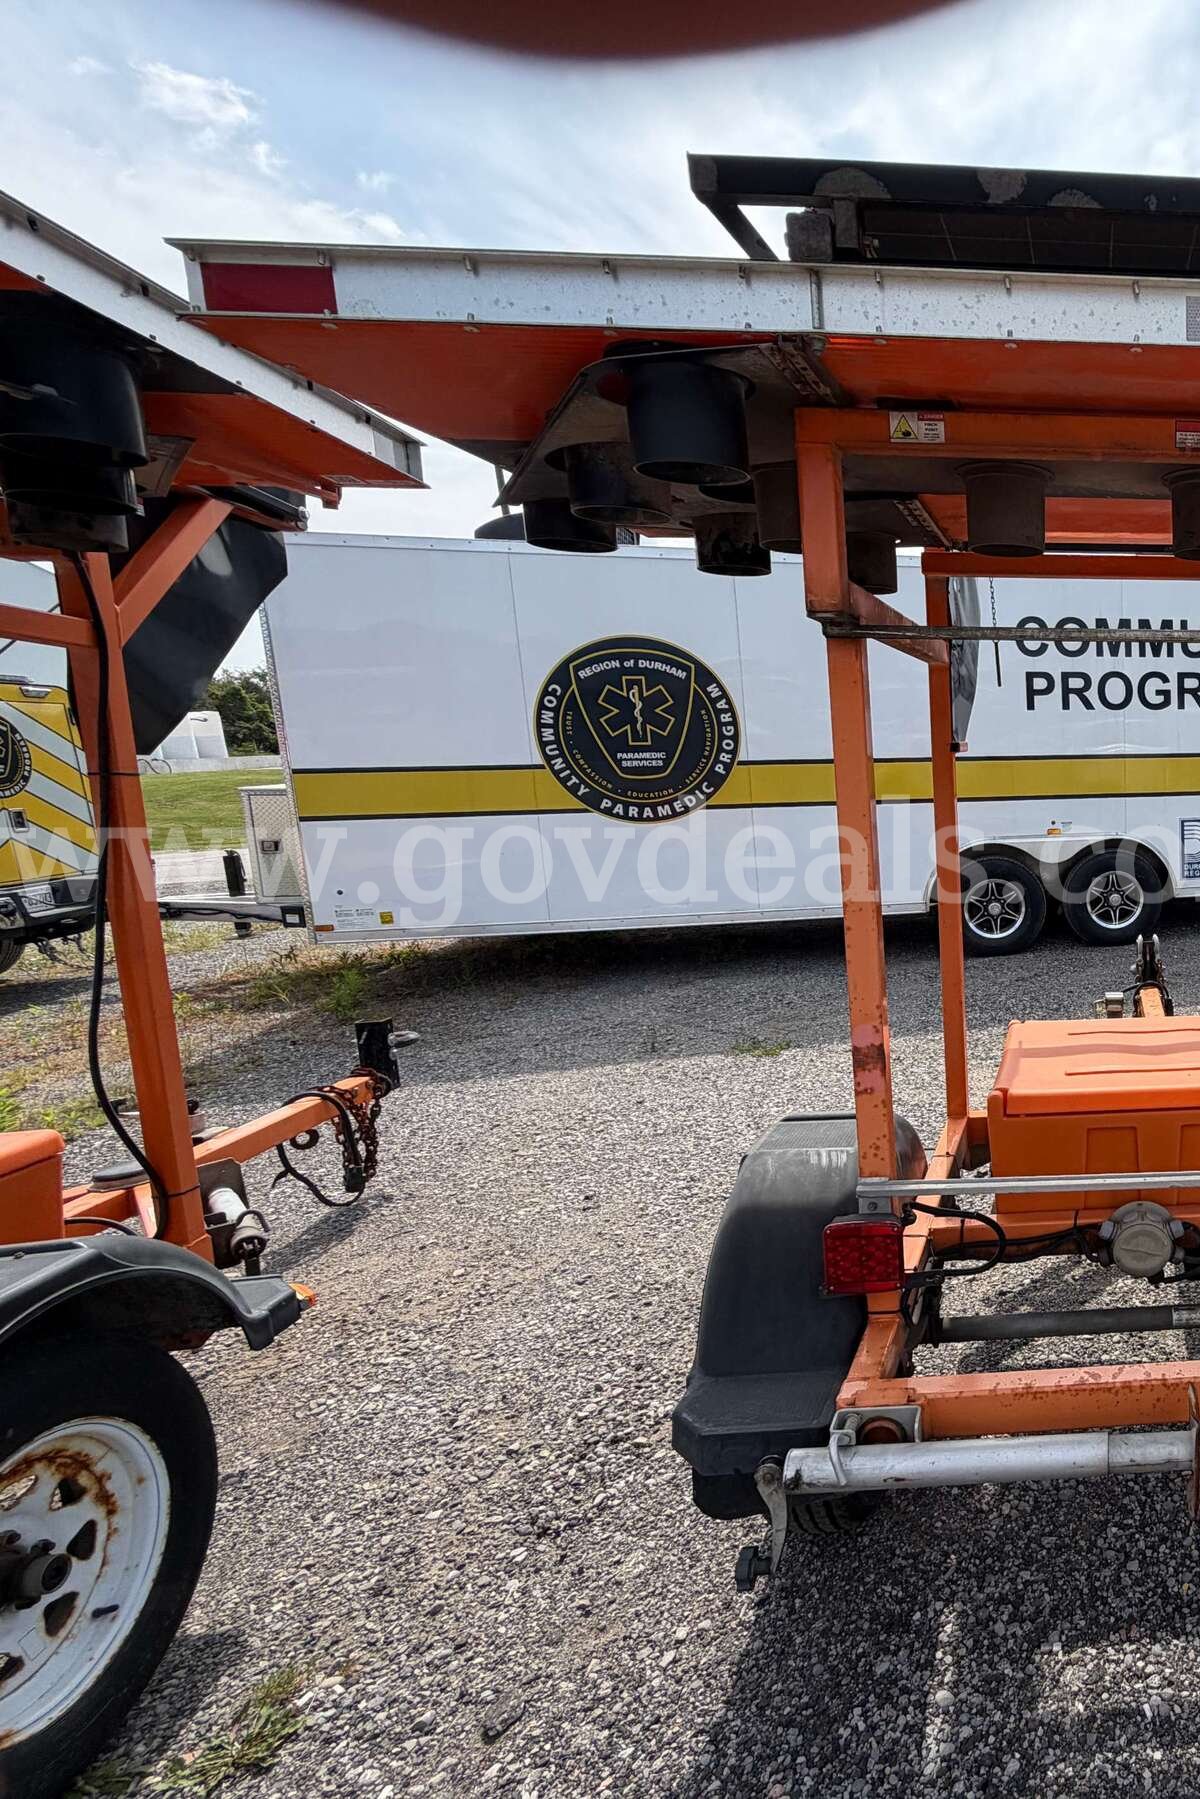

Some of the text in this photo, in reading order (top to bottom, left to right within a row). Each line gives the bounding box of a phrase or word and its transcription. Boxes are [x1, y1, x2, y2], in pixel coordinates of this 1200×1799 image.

[577, 659, 688, 680] REGION of DURHAM
[540, 682, 735, 819] COMMUNITY PARAMEDIC PROGRAM
[565, 708, 712, 798] TRUST COMPASSION EDUCATION SERVICE NAVIGATION
[616, 751, 667, 760] PARAMEDIC
[621, 760, 664, 768] SERVICES
